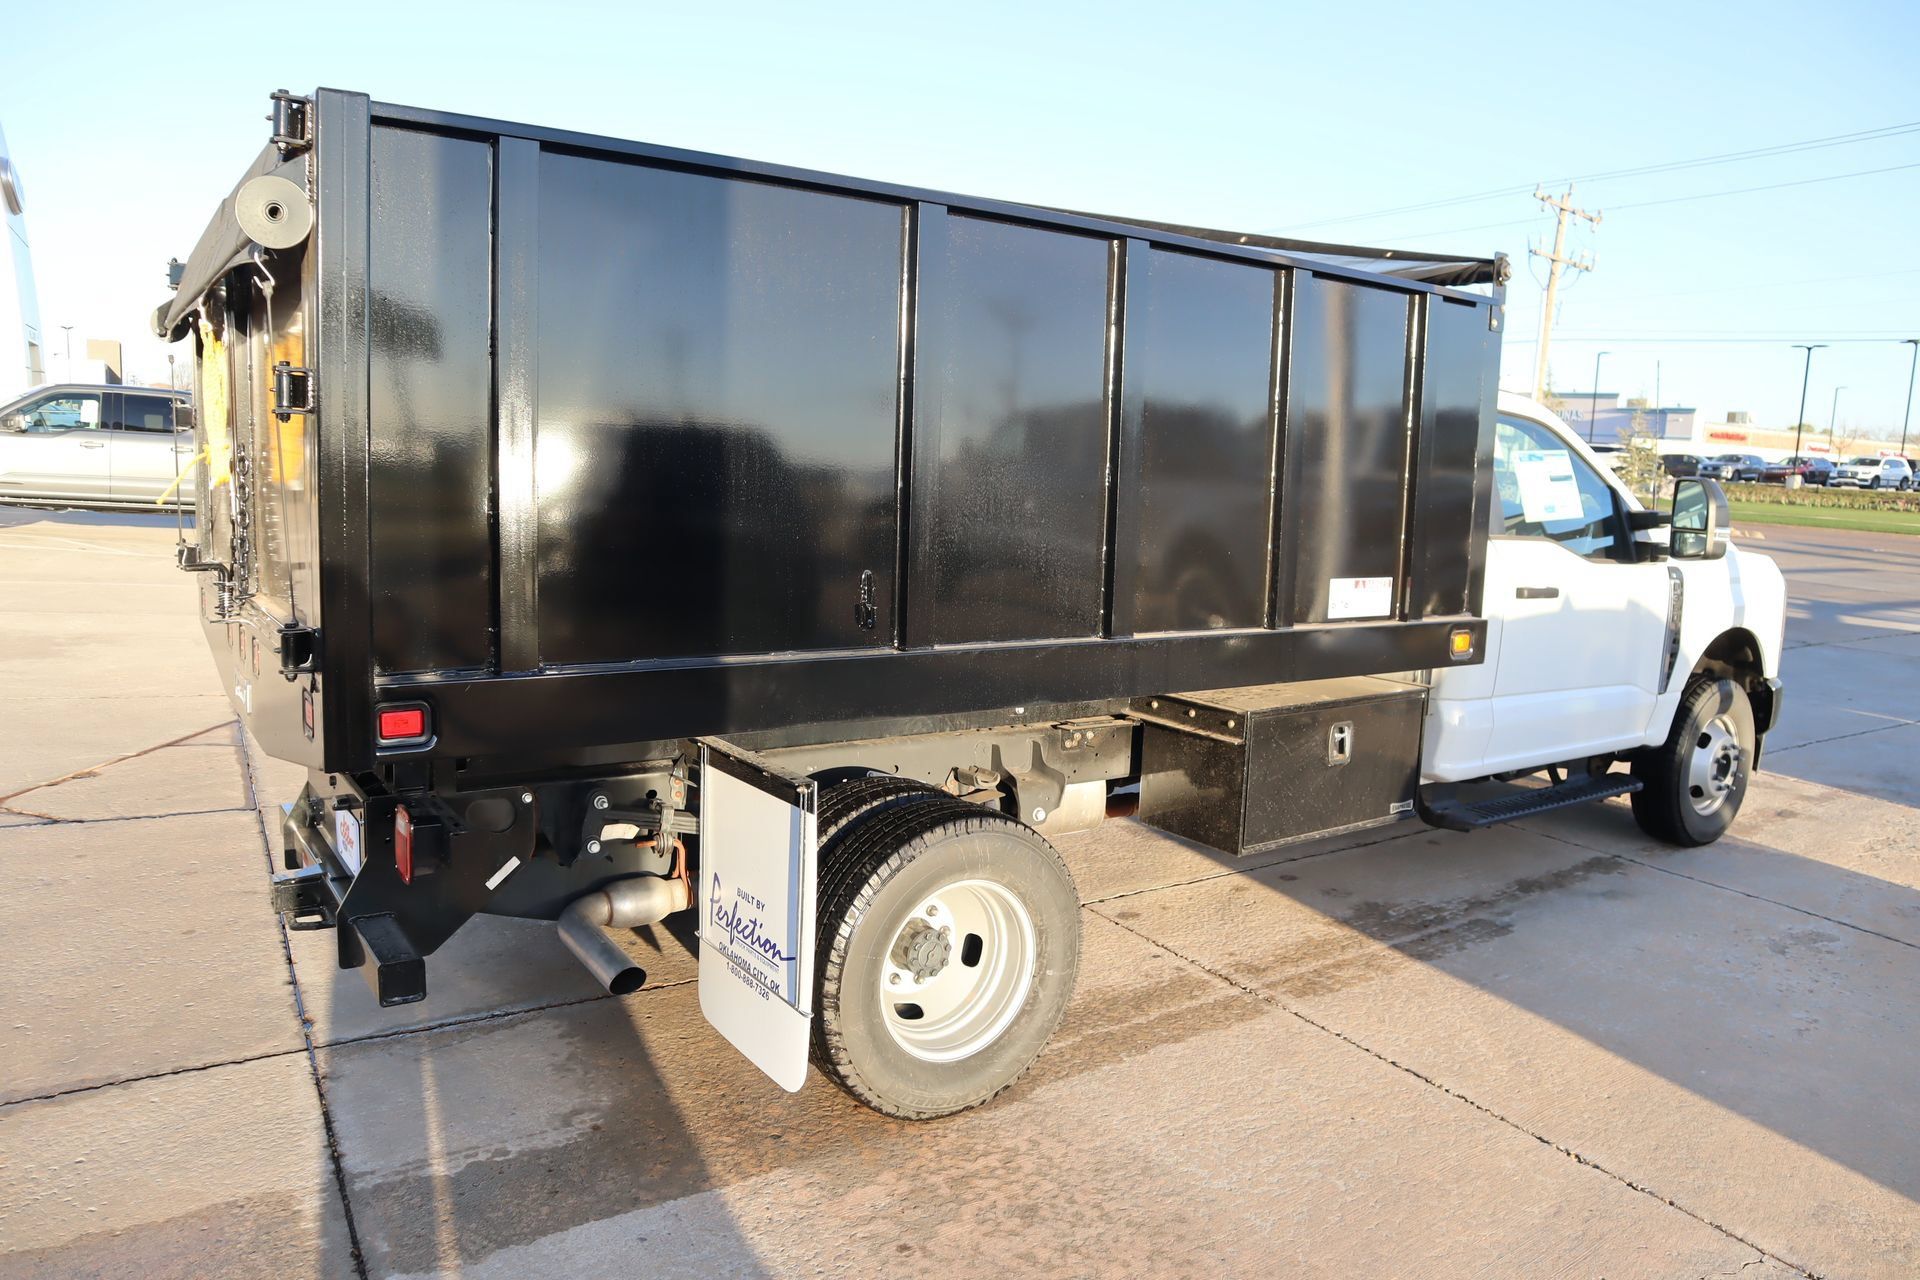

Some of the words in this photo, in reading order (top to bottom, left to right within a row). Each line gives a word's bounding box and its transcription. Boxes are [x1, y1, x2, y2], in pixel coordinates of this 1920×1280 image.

[709, 871, 796, 961] Perfection
[737, 887, 755, 906] BUILT
[756, 899, 766, 912] BY
[718, 941, 752, 974] OKLAHOMA
[769, 979, 780, 995] OK
[726, 961, 770, 1001] 1-800-888-7326
